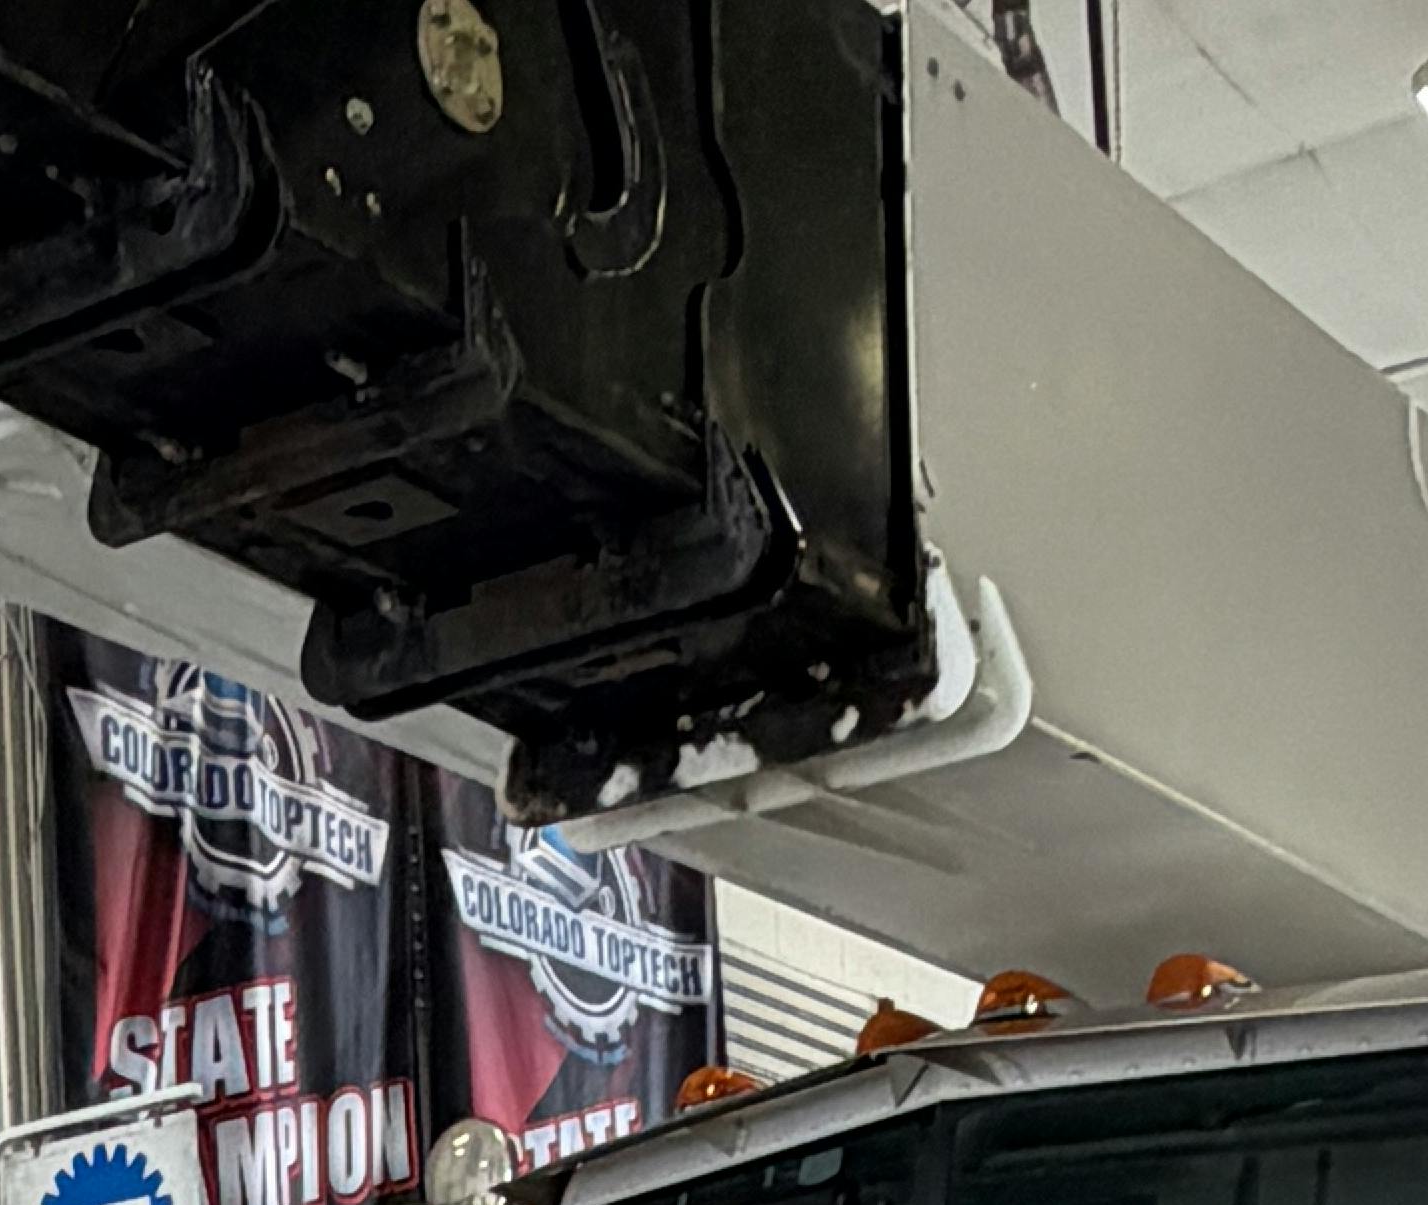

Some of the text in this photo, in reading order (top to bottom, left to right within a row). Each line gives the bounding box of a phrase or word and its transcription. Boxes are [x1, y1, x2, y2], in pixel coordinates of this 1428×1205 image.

[100, 712, 373, 874] COLORDO TOPTECH
[461, 873, 703, 997] COLORADO TOPTECH
[109, 981, 296, 1104] STATE
